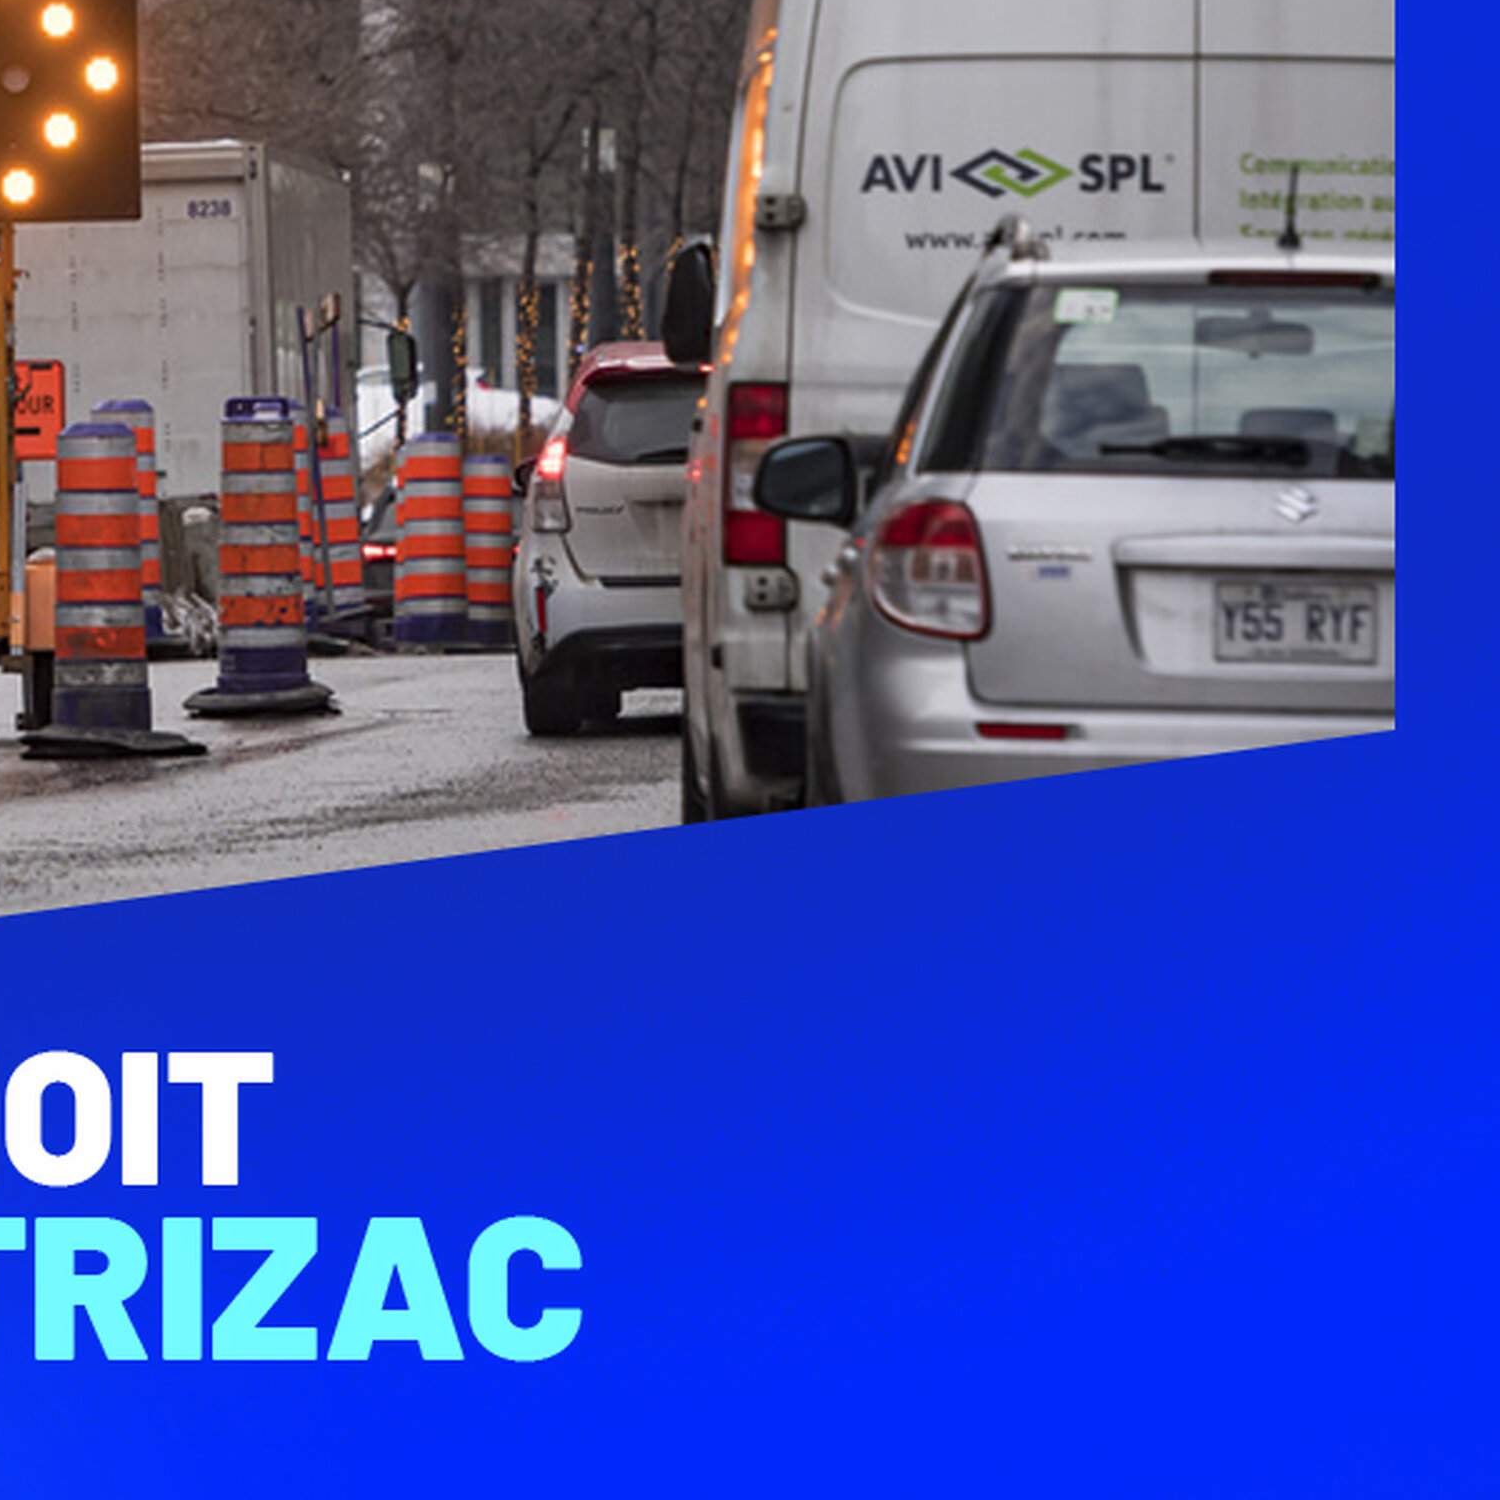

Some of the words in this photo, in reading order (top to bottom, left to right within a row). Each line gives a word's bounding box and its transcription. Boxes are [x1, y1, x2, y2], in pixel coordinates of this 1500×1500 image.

[860, 154, 942, 193] AVI
[1079, 154, 1165, 193] SPL
[1221, 601, 1284, 642] Y55
[1306, 604, 1372, 644] RYF
